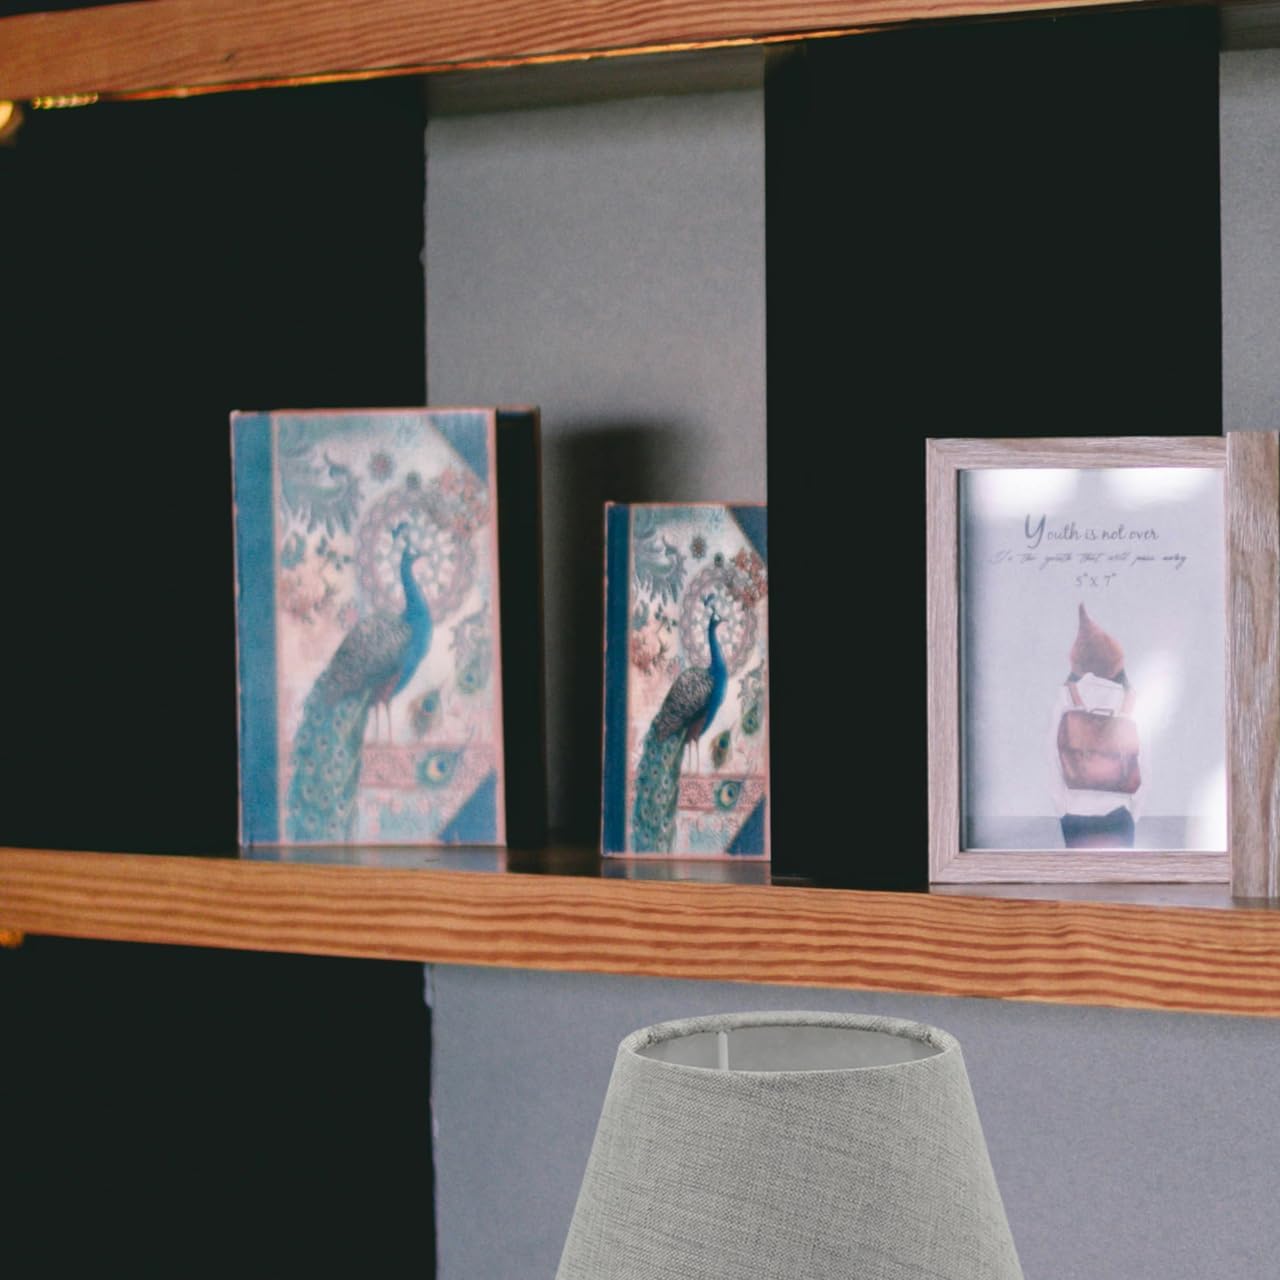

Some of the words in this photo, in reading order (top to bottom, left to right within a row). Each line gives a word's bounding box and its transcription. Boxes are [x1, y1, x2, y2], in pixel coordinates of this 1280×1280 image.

[1024, 513, 1080, 549] Youth
[1085, 528, 1097, 540] is
[1102, 524, 1125, 540] not
[1129, 532, 1159, 540] over
